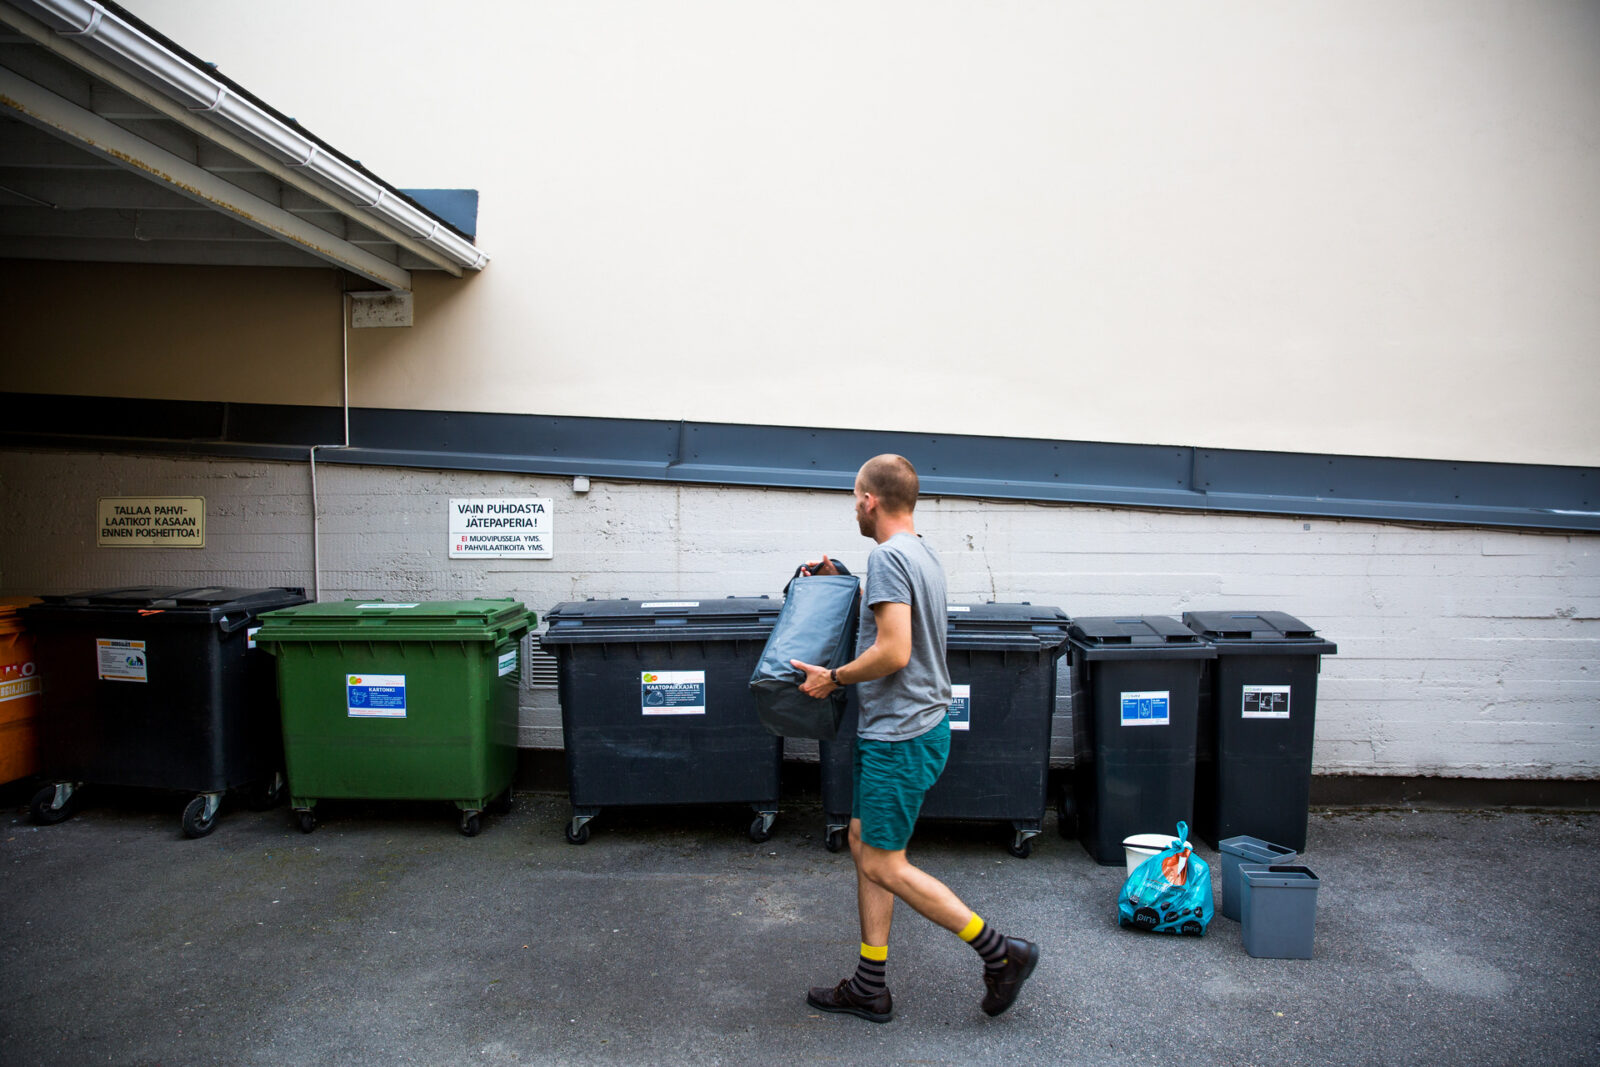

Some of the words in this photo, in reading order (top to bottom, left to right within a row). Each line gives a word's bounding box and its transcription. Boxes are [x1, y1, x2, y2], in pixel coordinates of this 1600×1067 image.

[114, 506, 151, 515] TALLAA
[154, 506, 188, 515] PAHVI-
[457, 504, 484, 514] VAIN
[487, 504, 545, 514] PUHDASTA
[105, 517, 152, 526] LAATIKOT
[154, 517, 196, 526] KASAAN
[465, 515, 538, 528] JÄTEPAPERIA!
[101, 528, 133, 537] ENNEN
[1136, 913, 1157, 924] pins
